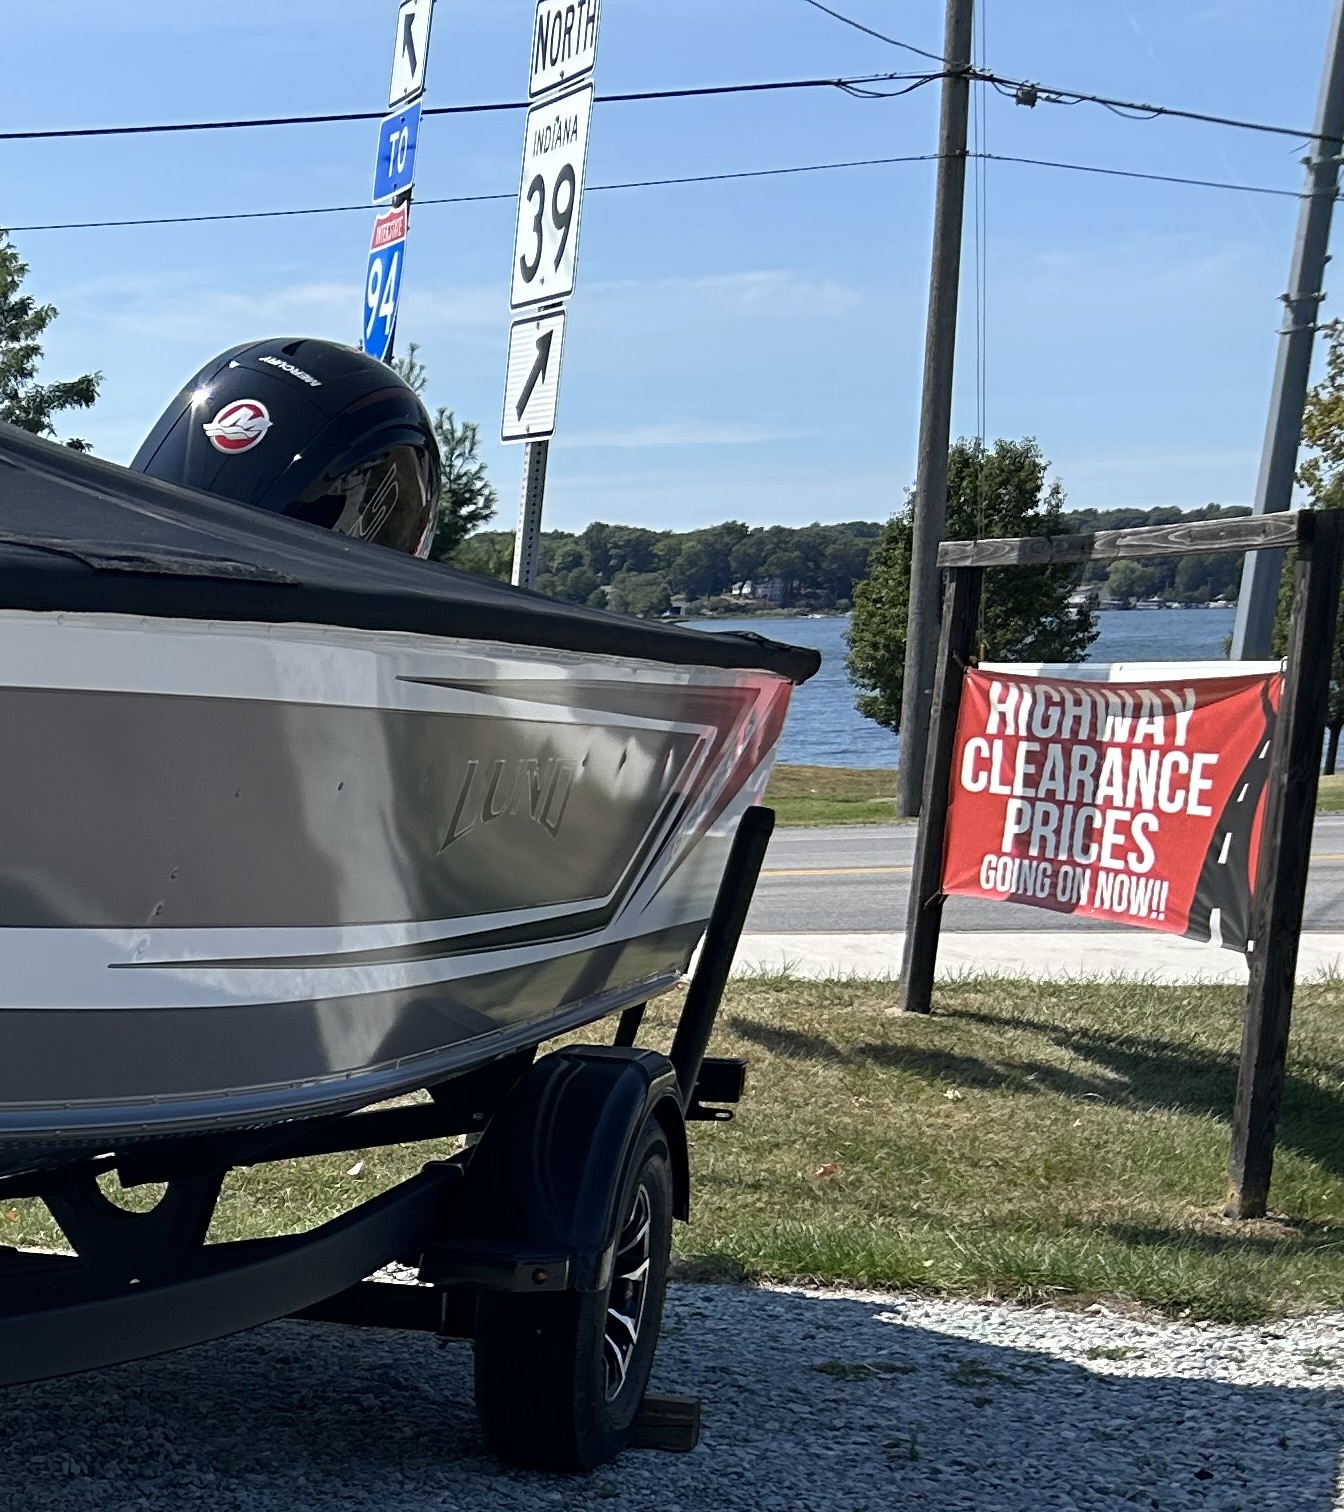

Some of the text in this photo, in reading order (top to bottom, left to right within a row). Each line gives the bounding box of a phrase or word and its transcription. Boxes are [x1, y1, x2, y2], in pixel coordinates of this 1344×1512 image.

[534, 0, 597, 74] NORTH
[389, 126, 410, 178] TO
[532, 114, 579, 158] INDIANA
[520, 163, 577, 284] 39
[366, 251, 399, 337] 94
[986, 681, 1196, 746] HIGHWAY
[436, 757, 579, 856] LUND
[962, 737, 1219, 817] CLEARANCE
[1001, 798, 1159, 874] PRICES
[980, 854, 1169, 920] GOING ON NOW!!
